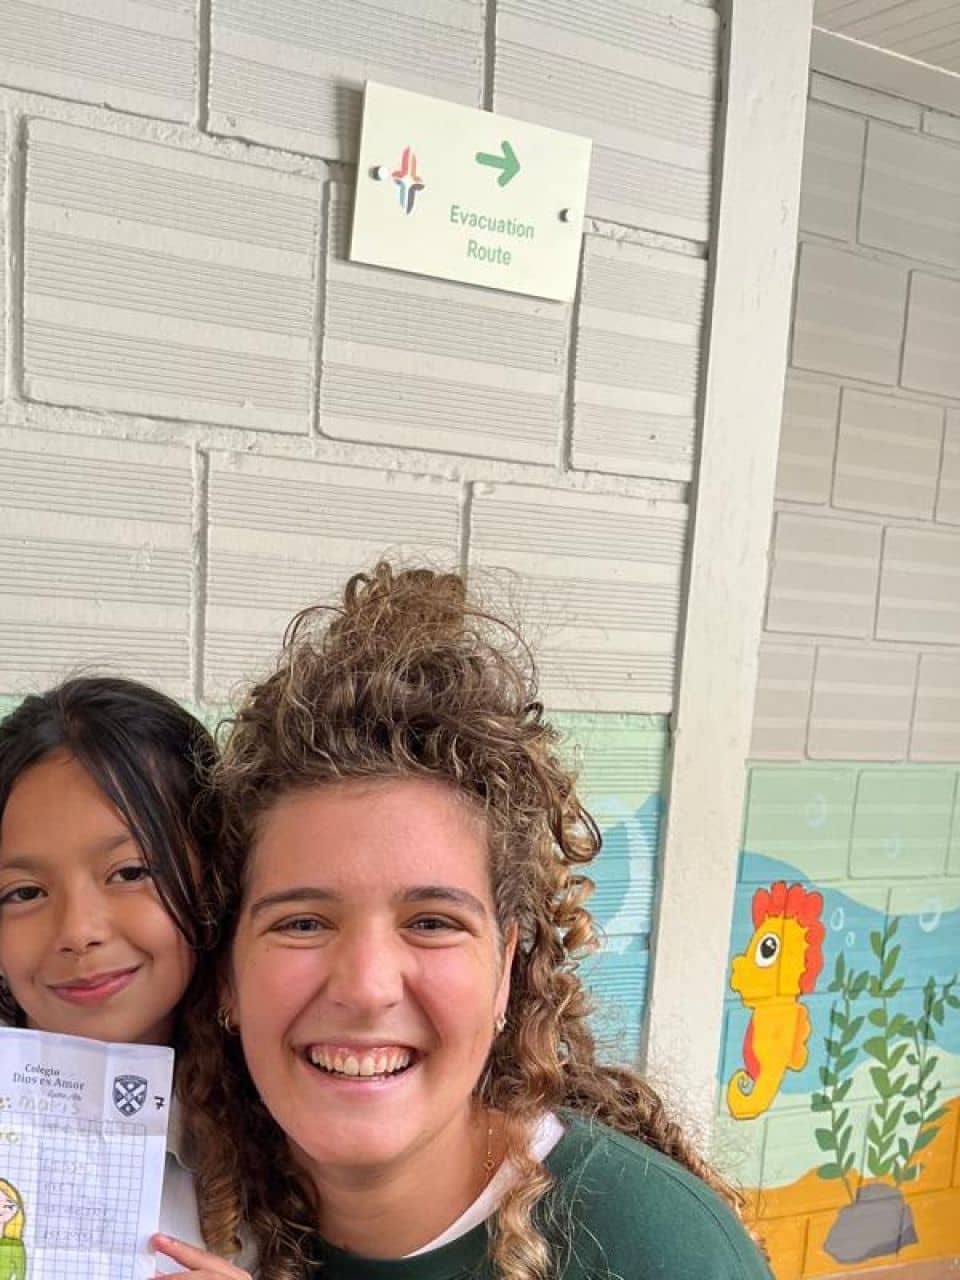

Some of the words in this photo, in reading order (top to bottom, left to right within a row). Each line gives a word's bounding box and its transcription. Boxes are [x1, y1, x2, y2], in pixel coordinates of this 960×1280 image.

[450, 204, 535, 239] Evacuation
[467, 239, 512, 265] Route
[54, 1077, 85, 1090] Amor
